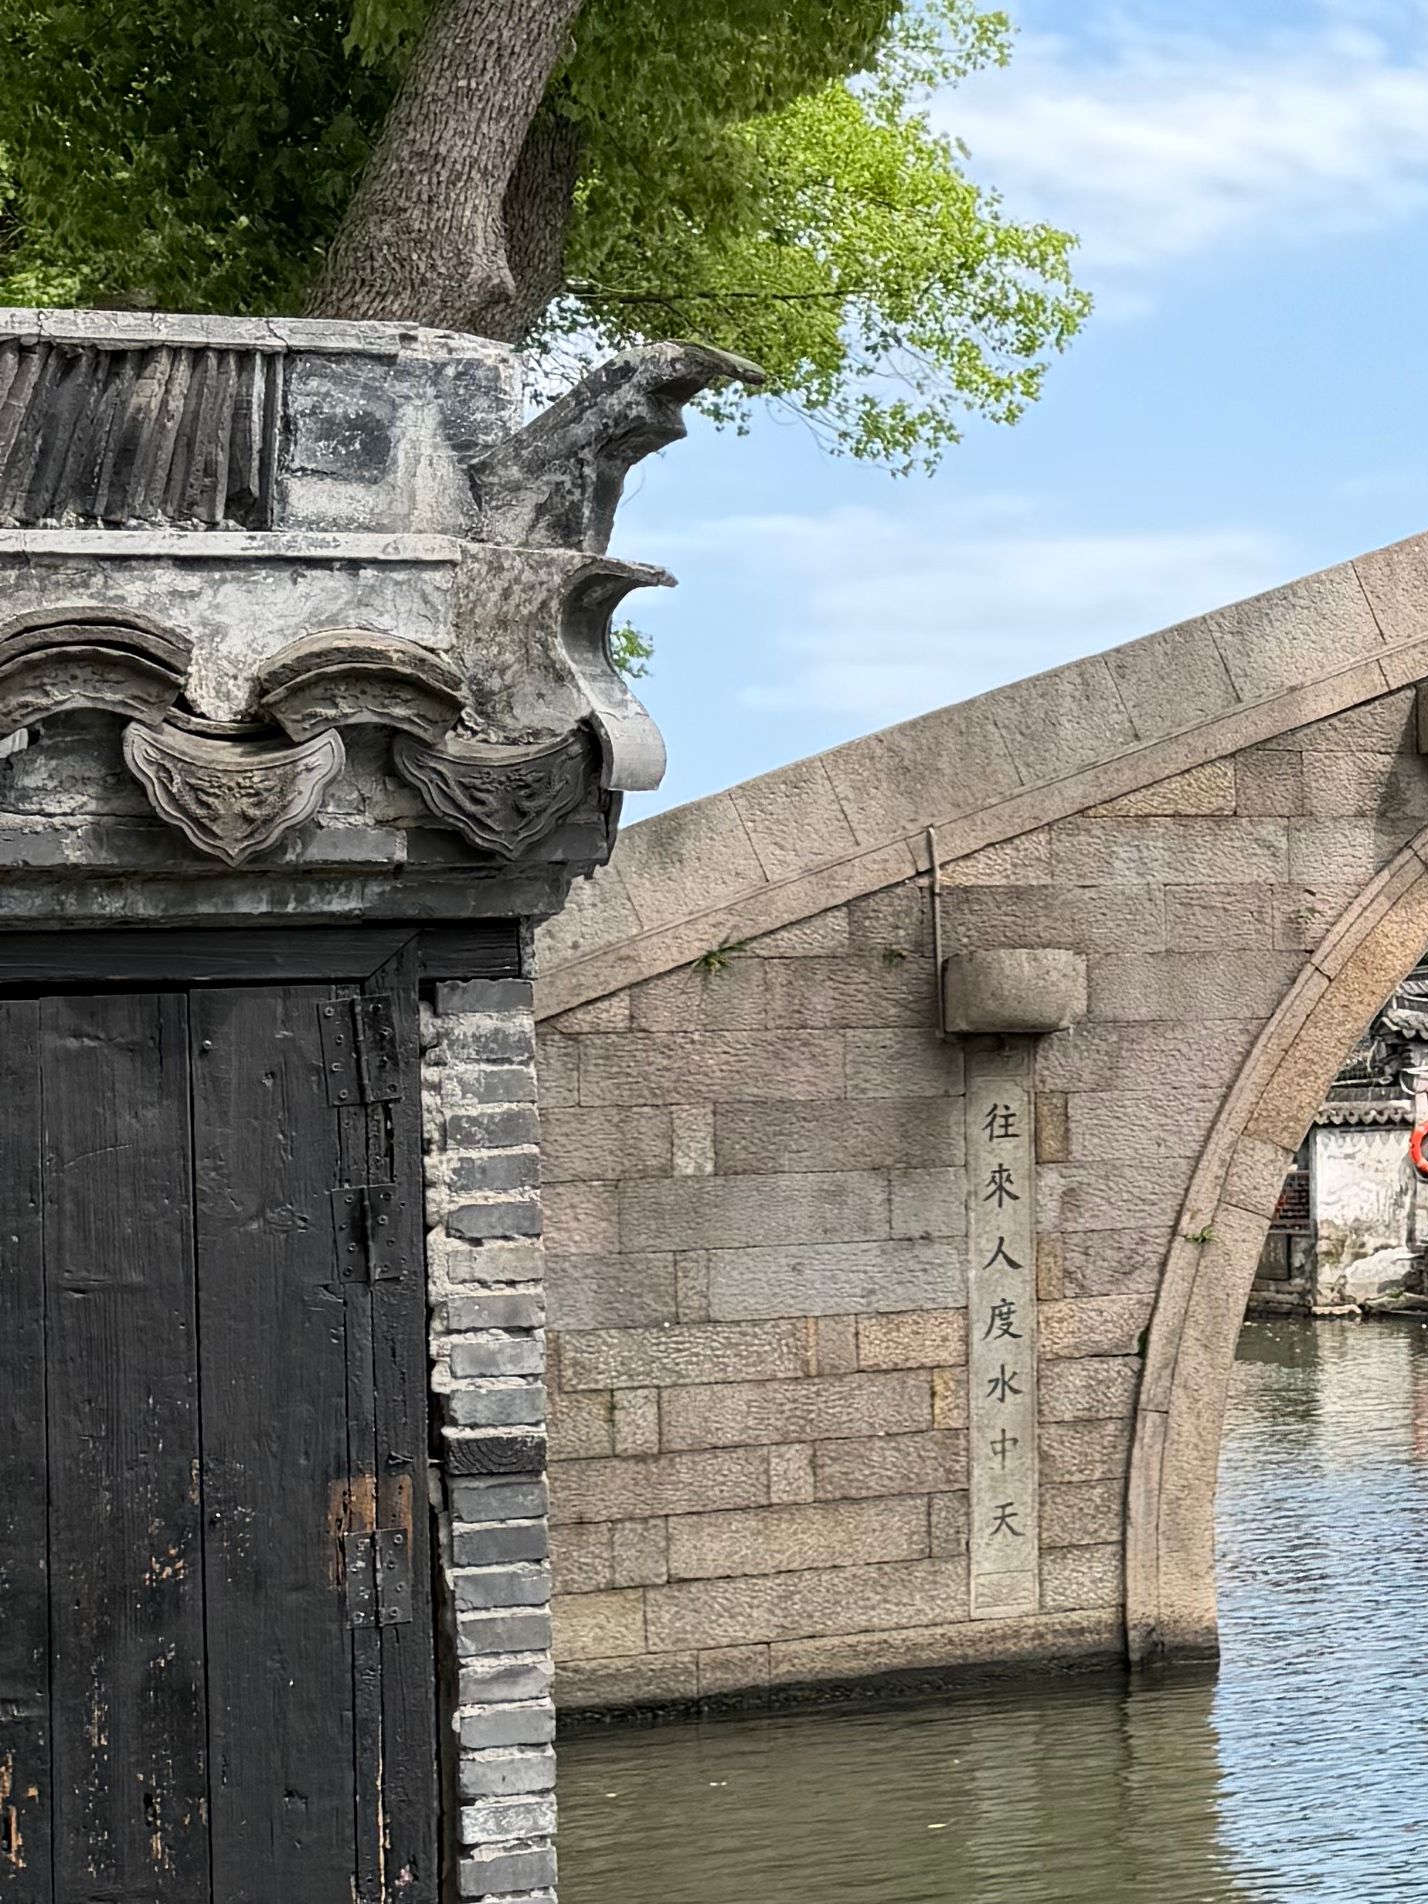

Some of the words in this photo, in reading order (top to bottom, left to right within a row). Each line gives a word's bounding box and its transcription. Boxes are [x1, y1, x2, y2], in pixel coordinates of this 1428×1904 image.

[981, 1102, 1025, 1537] 往來人度水中天
